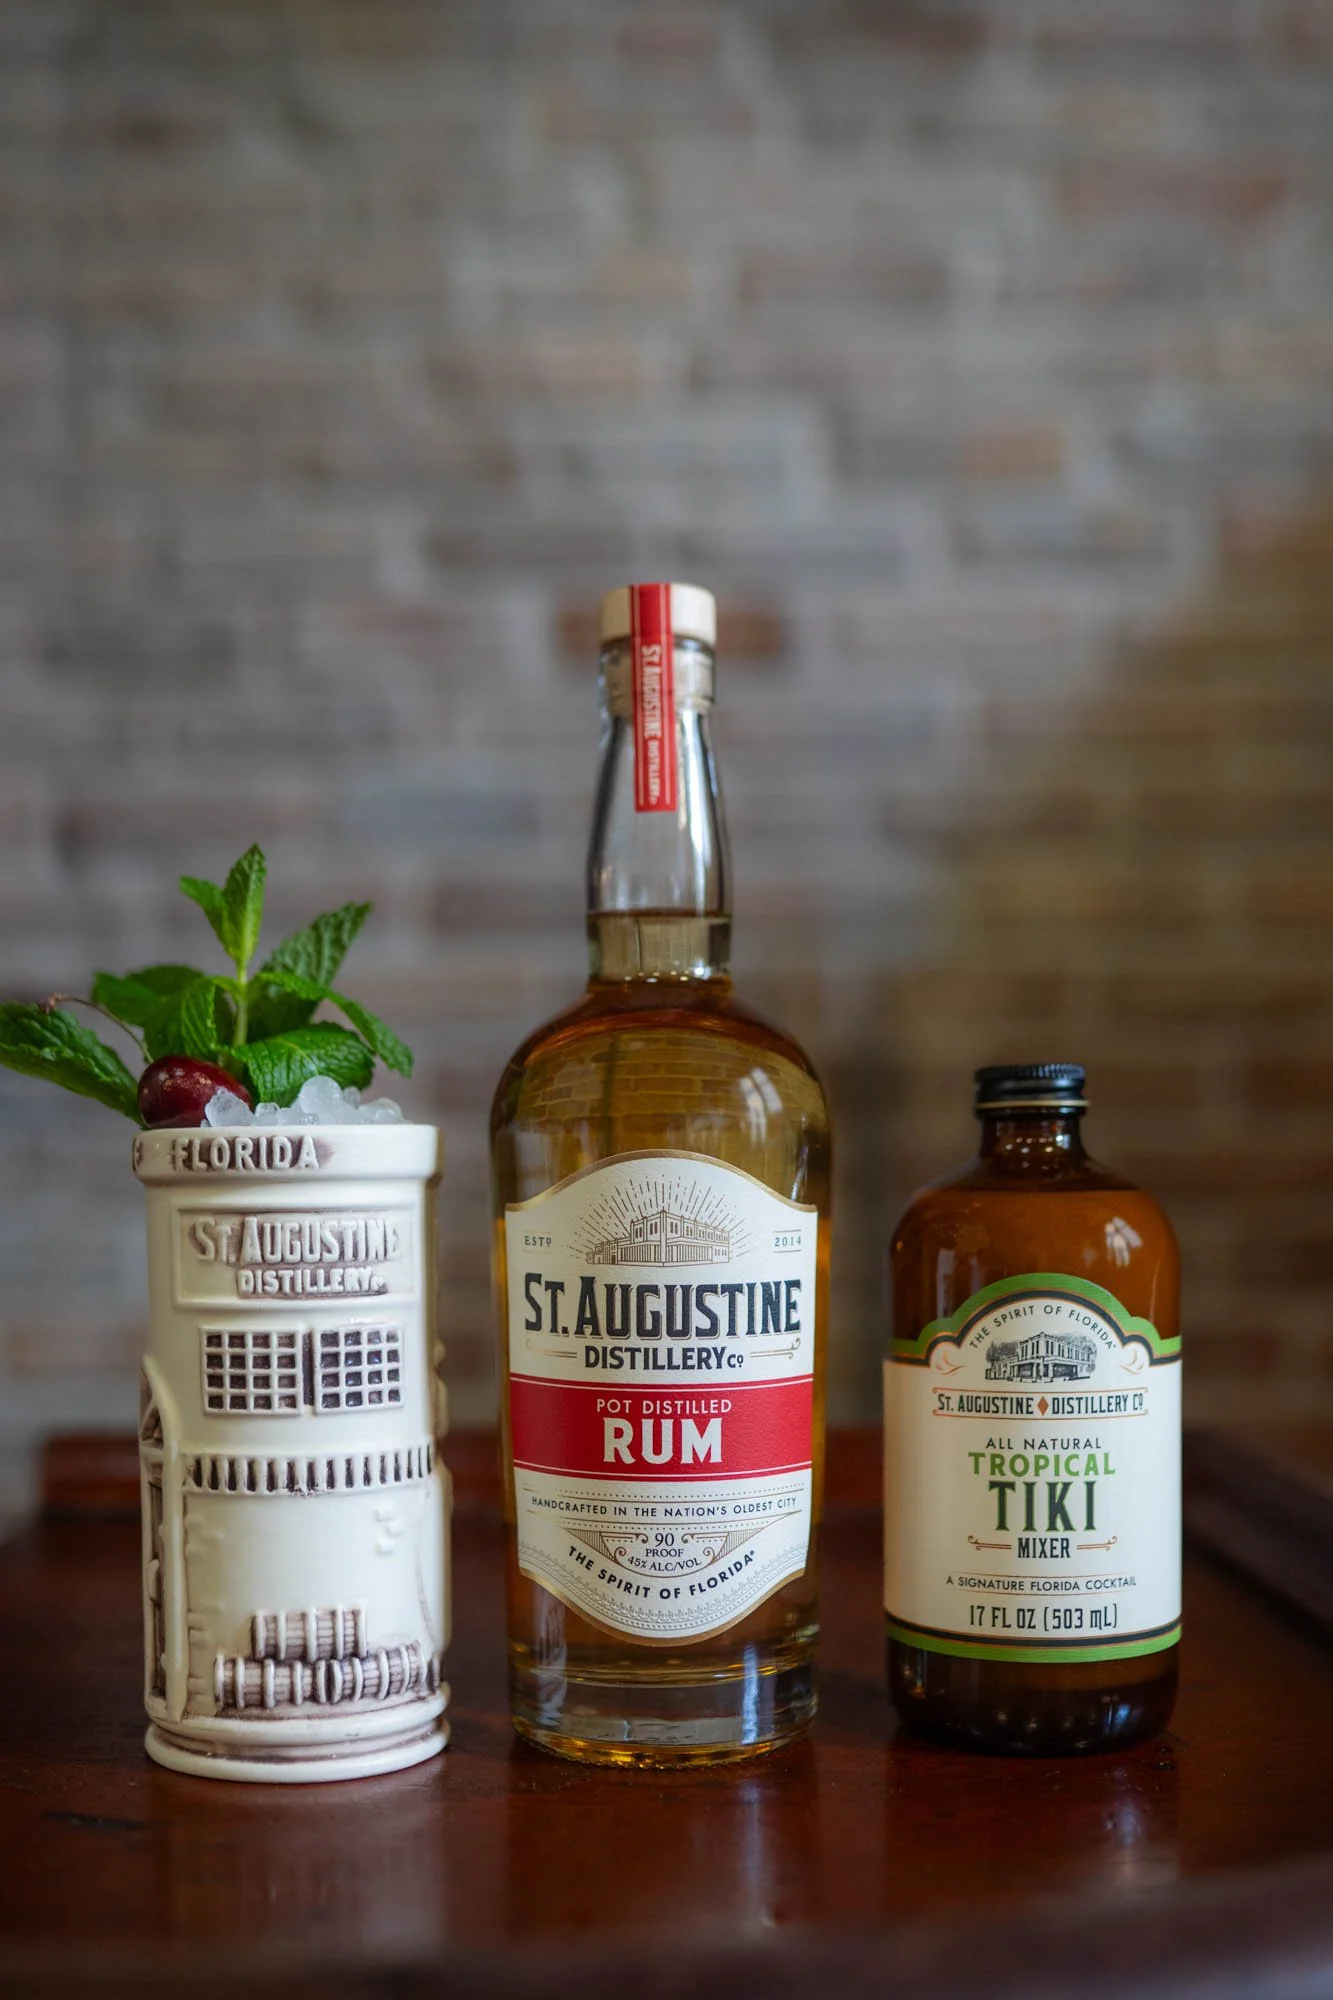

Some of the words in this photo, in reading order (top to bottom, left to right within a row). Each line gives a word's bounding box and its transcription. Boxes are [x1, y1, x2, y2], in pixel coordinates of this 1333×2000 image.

[172, 1135, 320, 1172] FLORIDA
[240, 1216, 401, 1265] AUGUSTINE
[774, 1235, 802, 1247] 2014
[238, 1266, 372, 1295] DISTILLERY
[575, 1275, 802, 1340] AUGUSTINE
[969, 1327, 991, 1349] THE
[993, 1305, 1035, 1328] SPIRIT
[1043, 1304, 1062, 1315] OF
[584, 1345, 726, 1370] DISTILLERY
[596, 1399, 632, 1413] POT
[642, 1399, 732, 1414] DISTILLED
[958, 1396, 1034, 1415] AUGUSTINE
[1052, 1395, 1128, 1416] DISTILLERY
[603, 1417, 723, 1465] RUM
[986, 1437, 1014, 1449] ALL
[1024, 1437, 1101, 1450] NATURAL
[968, 1452, 1116, 1477] TROPICAL
[531, 1496, 607, 1516] HANDCRAFTED
[614, 1507, 627, 1516] IN
[634, 1507, 657, 1517] THE
[664, 1506, 727, 1517] NATION'S
[733, 1501, 773, 1514] OLDEST
[777, 1497, 797, 1509] CITY
[988, 1480, 1097, 1532] TIKI
[645, 1548, 684, 1558] PROOF
[654, 1533, 674, 1548] 90
[1017, 1537, 1070, 1559] MIXER
[568, 1546, 593, 1571] THE
[598, 1569, 650, 1598] SPIRIT
[659, 1587, 681, 1600] OF
[627, 1556, 647, 1570] 45%
[649, 1557, 702, 1572] ALC/VOL
[946, 1576, 954, 1585] A
[958, 1577, 1024, 1591] SIGNATURE
[1031, 1580, 1080, 1591] FLORIDA
[1085, 1576, 1136, 1590] COCKTAIL
[970, 1605, 984, 1626] 17
[991, 1607, 1011, 1629] FL
[1017, 1607, 1036, 1629] OZ
[1044, 1607, 1083, 1631] (503
